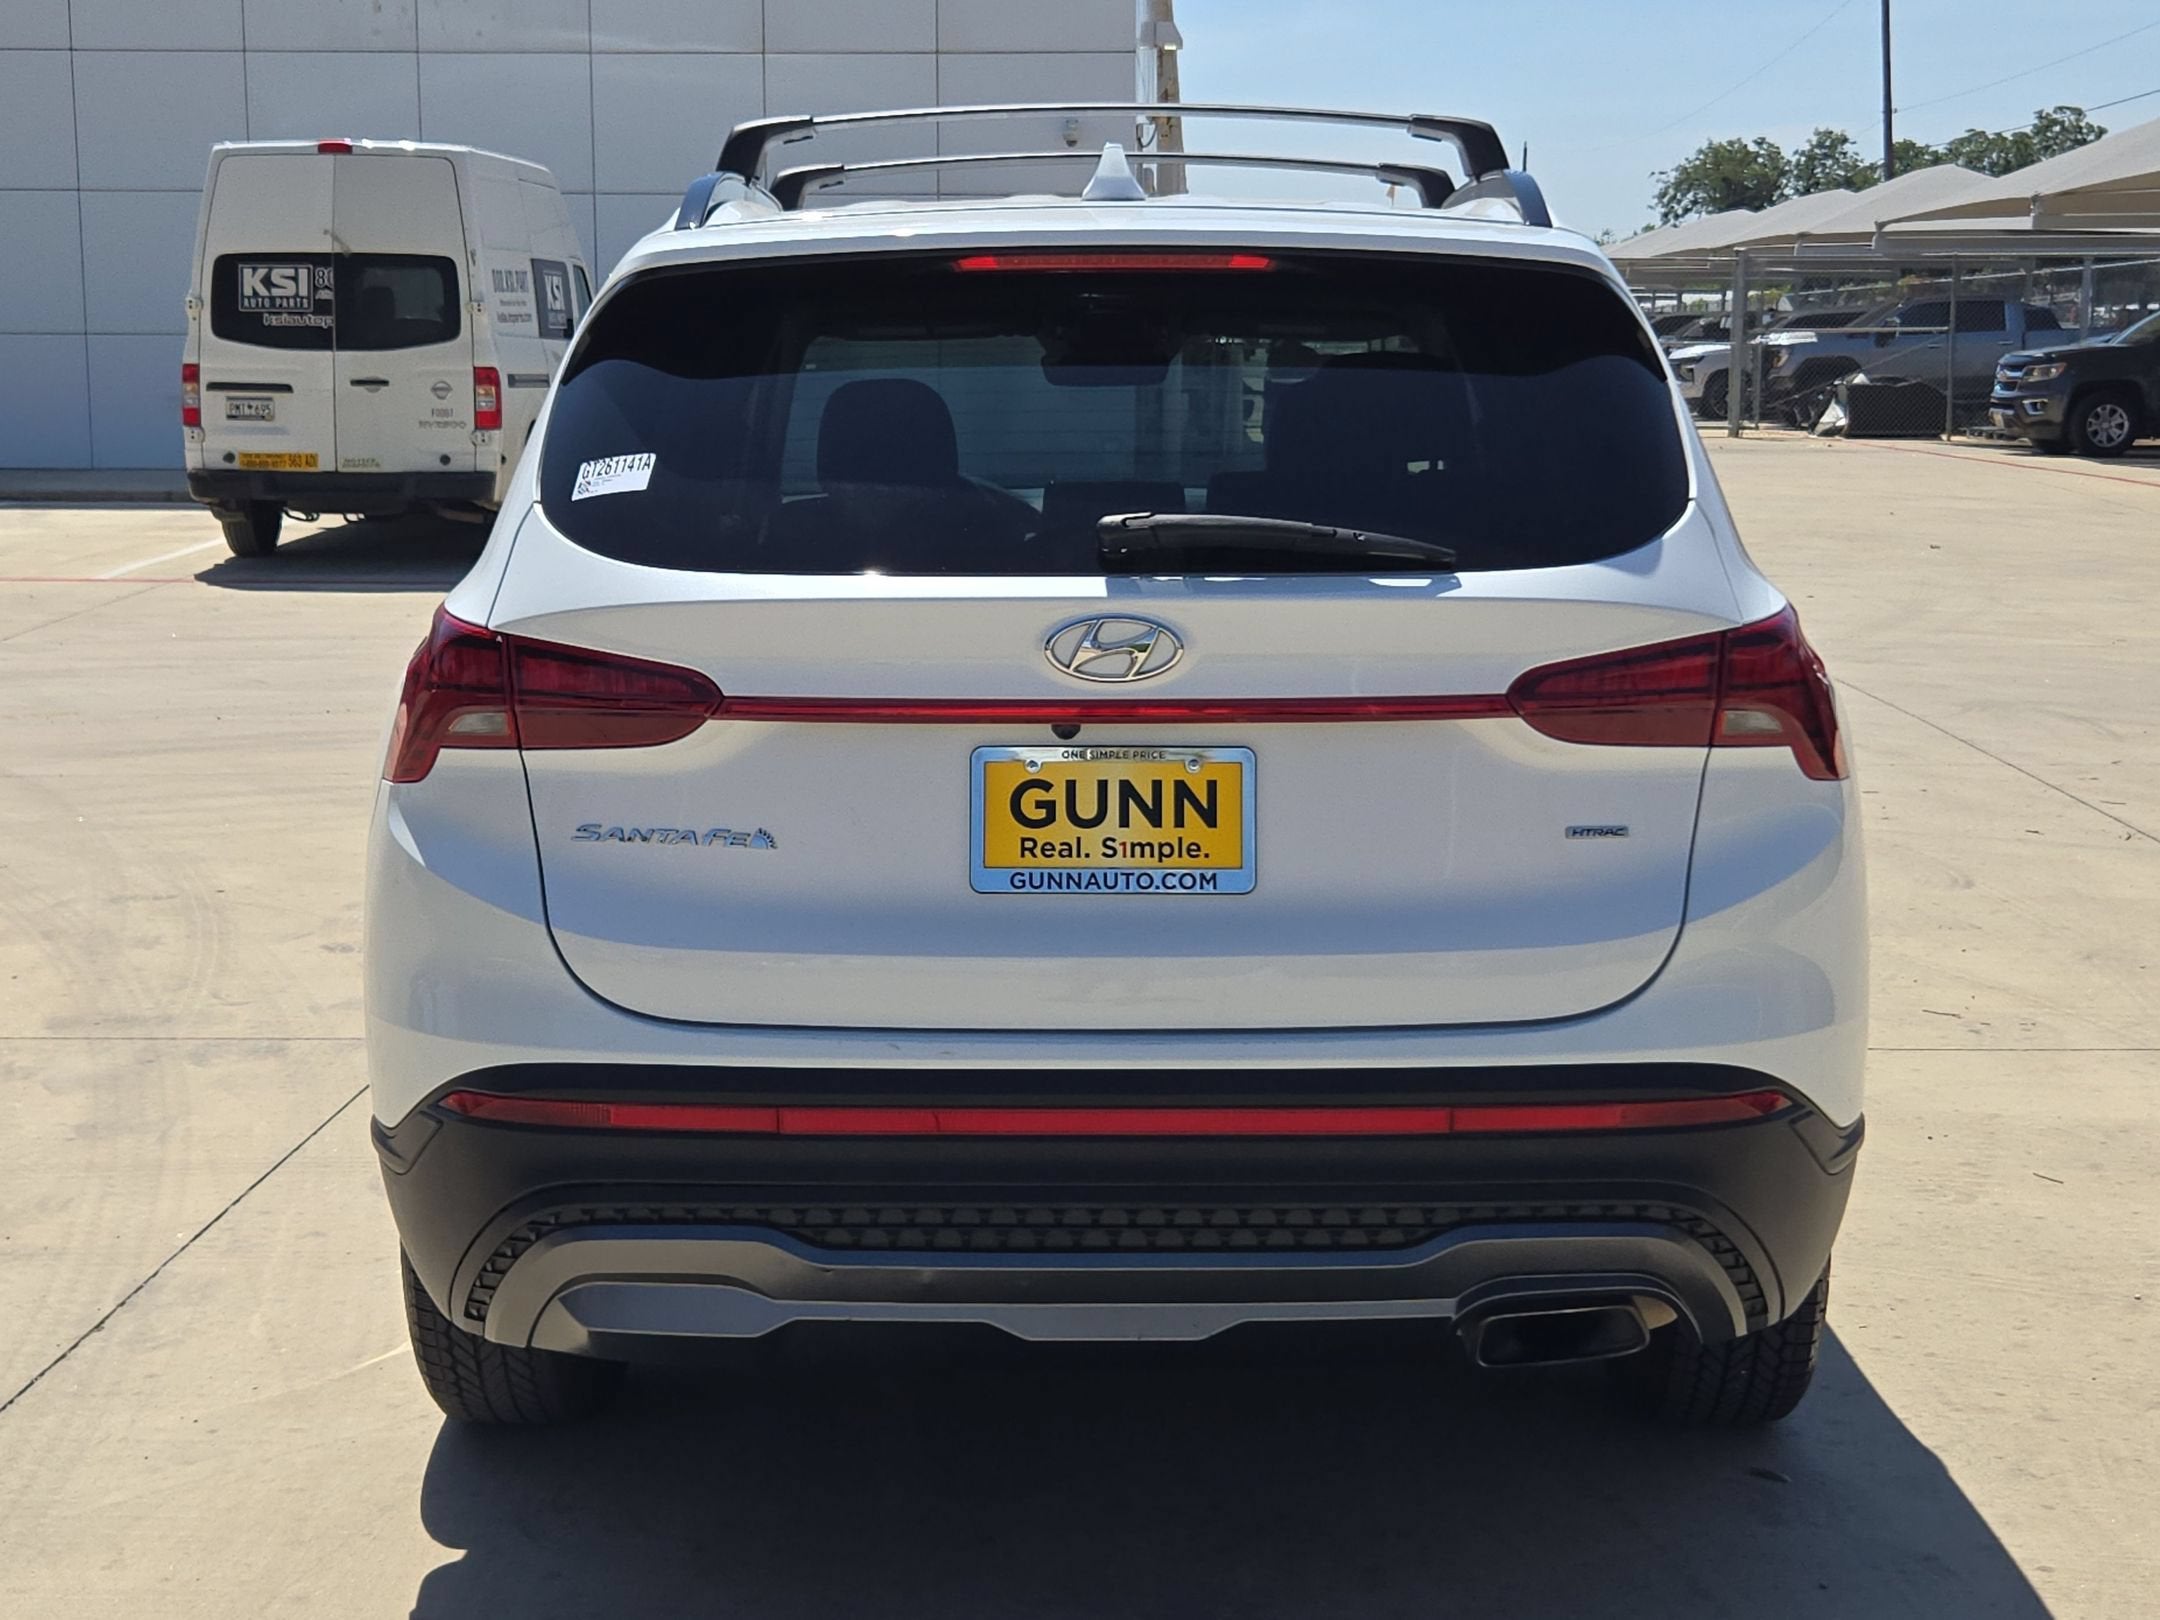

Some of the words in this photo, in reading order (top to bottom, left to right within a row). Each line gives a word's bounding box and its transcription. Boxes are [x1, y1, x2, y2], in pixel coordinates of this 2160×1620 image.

[243, 268, 308, 296] KSI
[242, 298, 271, 309] AUTO
[275, 298, 309, 309] PARTS
[1061, 750, 1086, 760] ONE
[1088, 750, 1129, 760] SIMPLE
[1132, 750, 1167, 760] PRICE
[1009, 778, 1218, 829] GUNN
[571, 823, 700, 846] SANTA
[1572, 828, 1625, 837] HTRAC
[1019, 836, 1091, 859] Real.
[1010, 871, 1218, 890] GUNNAUTO.COM
